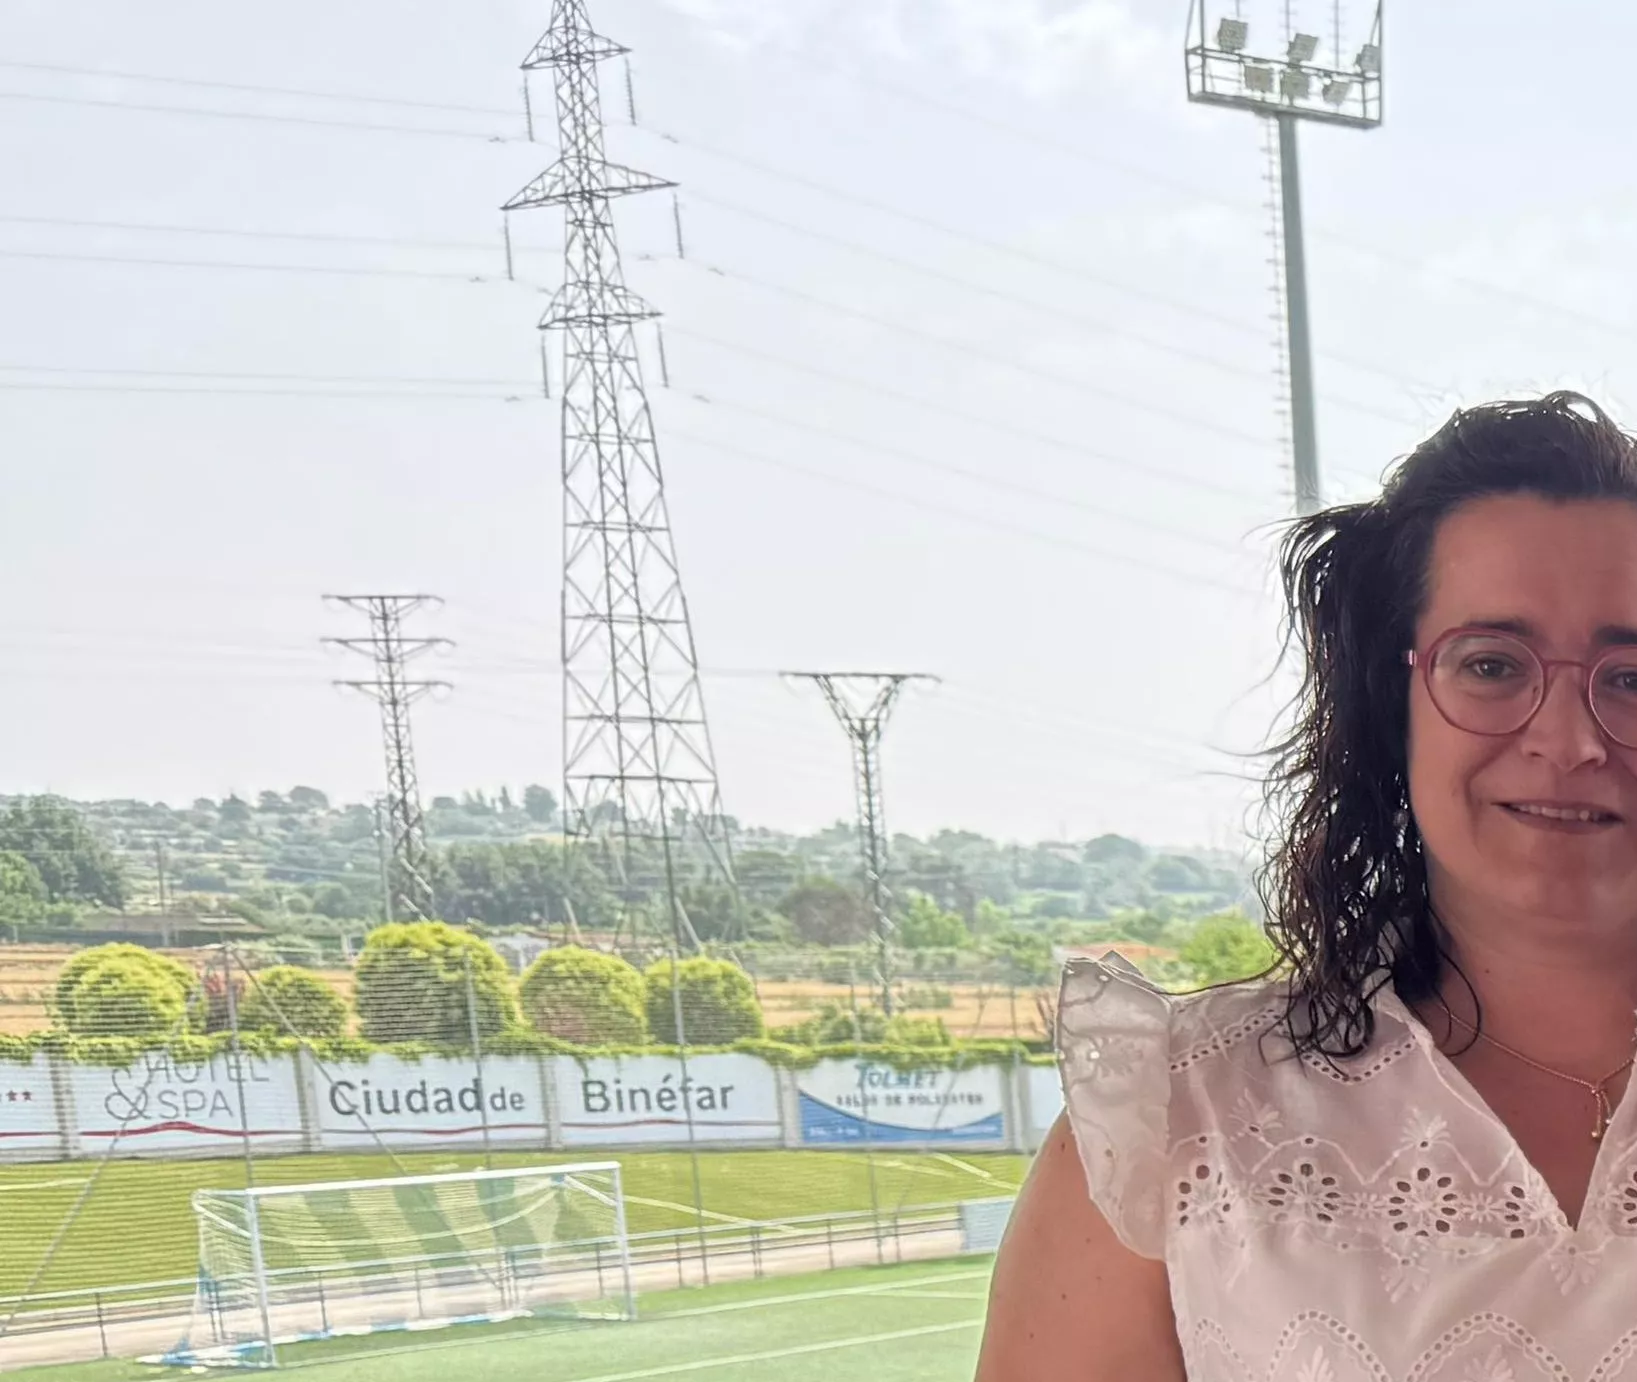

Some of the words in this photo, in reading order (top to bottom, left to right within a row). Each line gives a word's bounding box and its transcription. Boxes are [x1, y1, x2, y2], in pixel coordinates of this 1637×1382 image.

[158, 1089, 234, 1119] SPA
[330, 1078, 485, 1116] Ciudad
[489, 1086, 525, 1112] de
[581, 1074, 735, 1115] Binéfar
